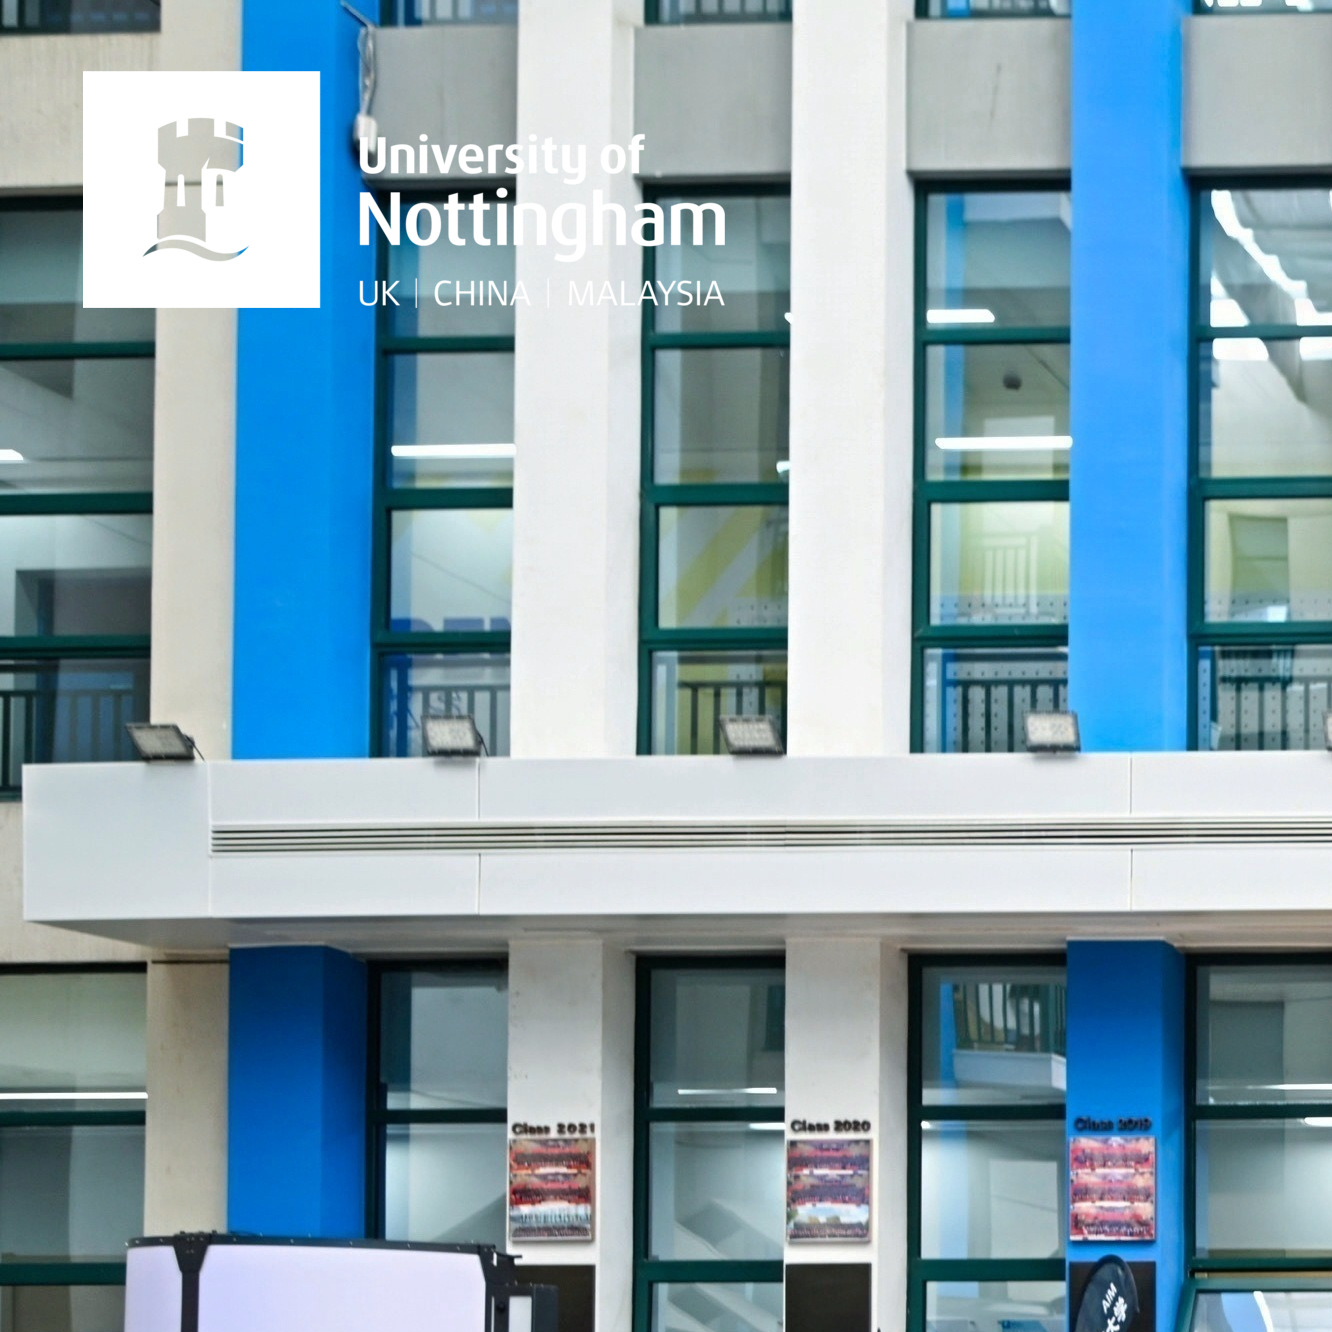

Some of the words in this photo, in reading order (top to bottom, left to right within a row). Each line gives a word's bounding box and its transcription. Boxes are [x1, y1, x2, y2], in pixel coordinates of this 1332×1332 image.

[512, 1123, 551, 1135] Class
[790, 1120, 829, 1132] Class
[834, 1120, 870, 1132] 2020
[1074, 1118, 1113, 1131] Class
